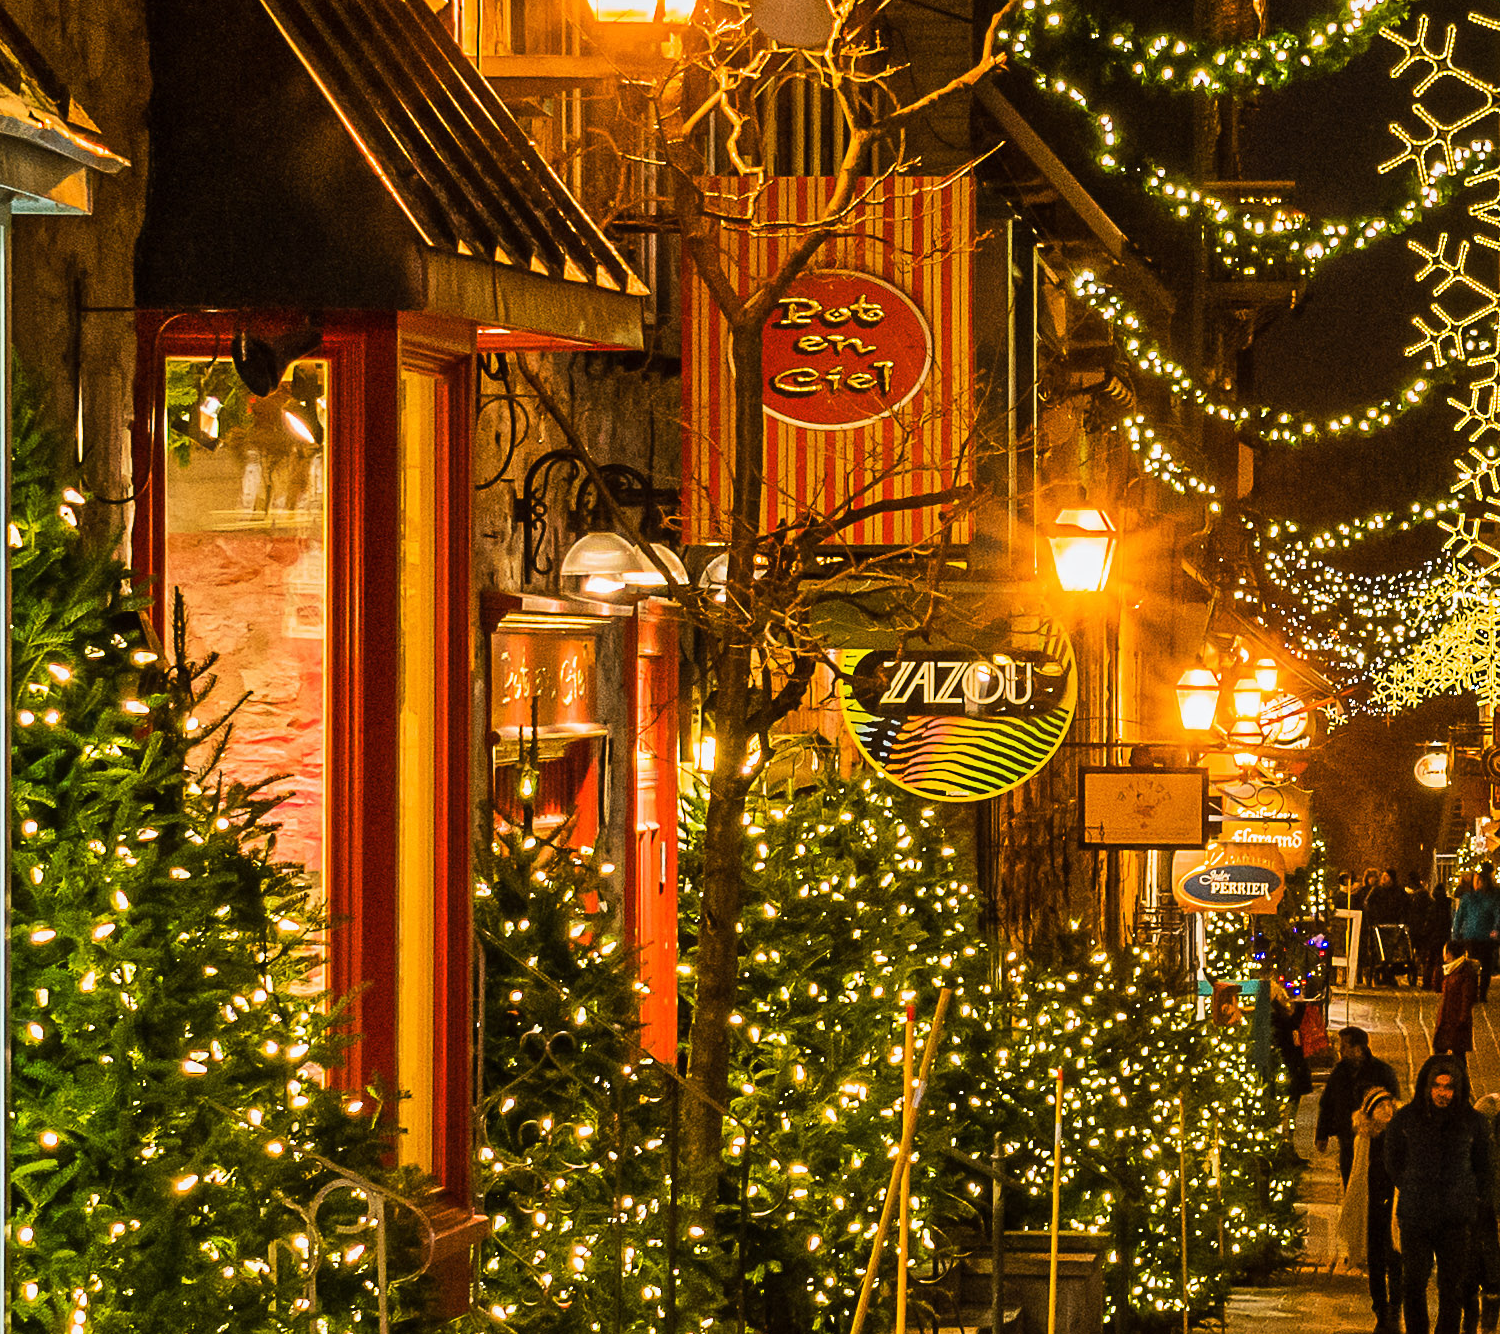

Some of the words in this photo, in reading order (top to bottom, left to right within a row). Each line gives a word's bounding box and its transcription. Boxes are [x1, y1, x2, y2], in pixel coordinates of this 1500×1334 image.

[778, 294, 885, 325] Pot
[798, 335, 877, 354] en
[774, 360, 894, 393] Ciel
[880, 661, 1032, 705] ZAZOU
[1199, 870, 1231, 885] Jules
[1211, 881, 1272, 901] PERRIER
